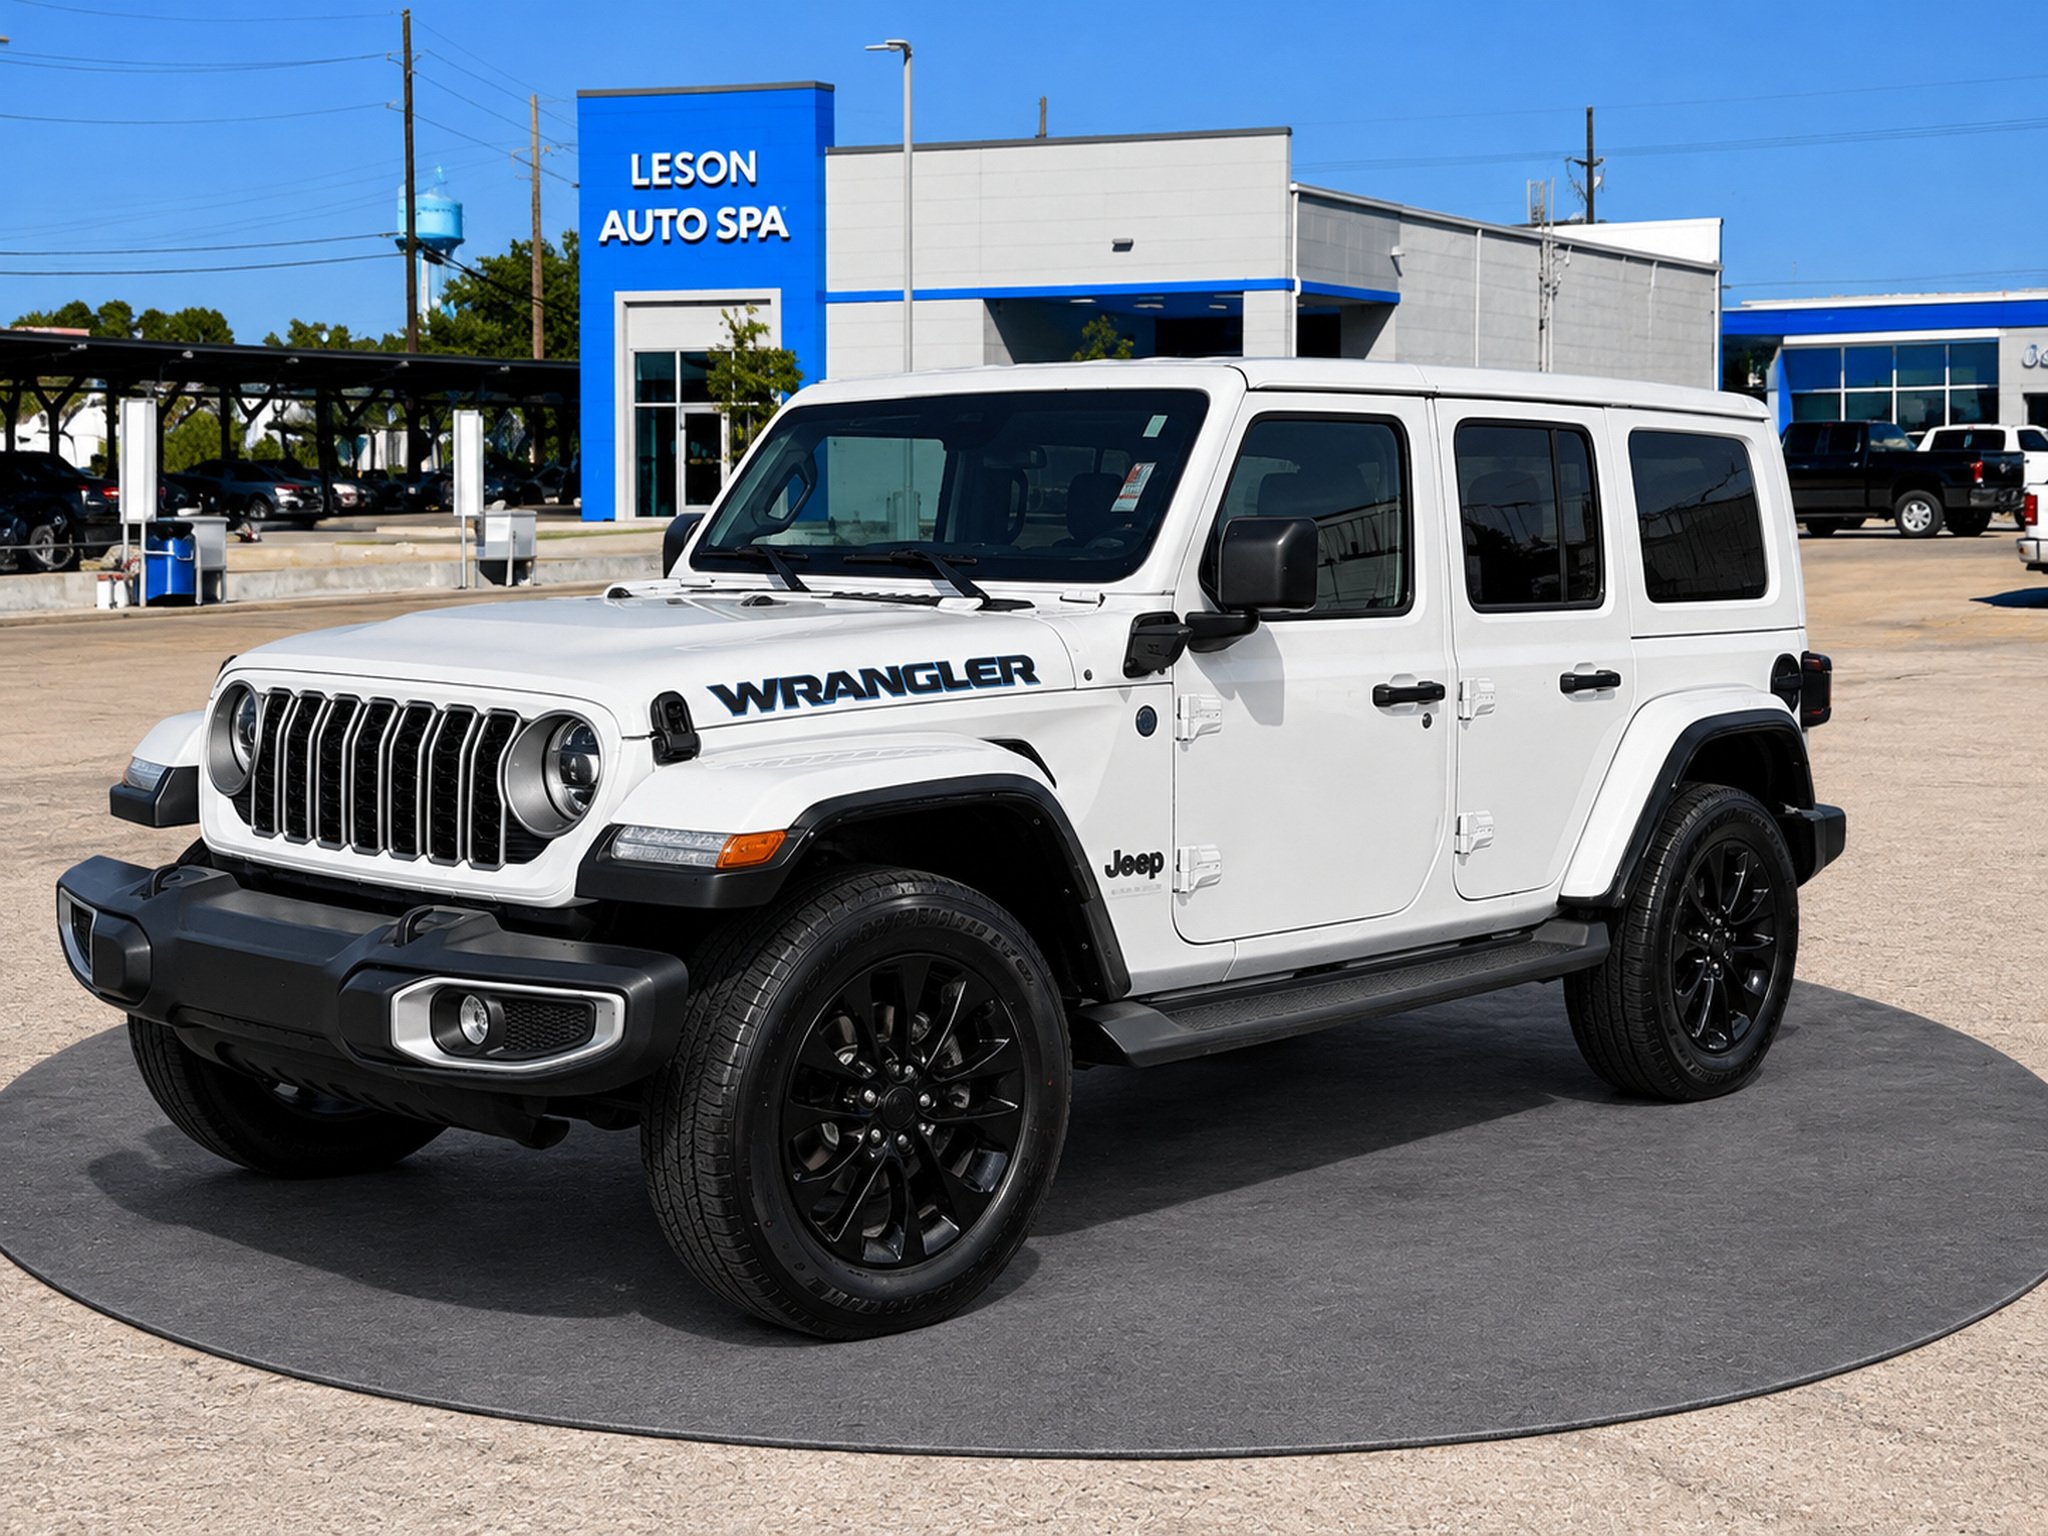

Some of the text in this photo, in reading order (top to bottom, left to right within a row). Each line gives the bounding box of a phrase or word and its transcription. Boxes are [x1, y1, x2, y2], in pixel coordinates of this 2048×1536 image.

[631, 150, 757, 187] LESON
[598, 205, 790, 243] AUTO SPA
[706, 654, 1041, 717] WRANGLER
[1104, 849, 1165, 880] Jeep
